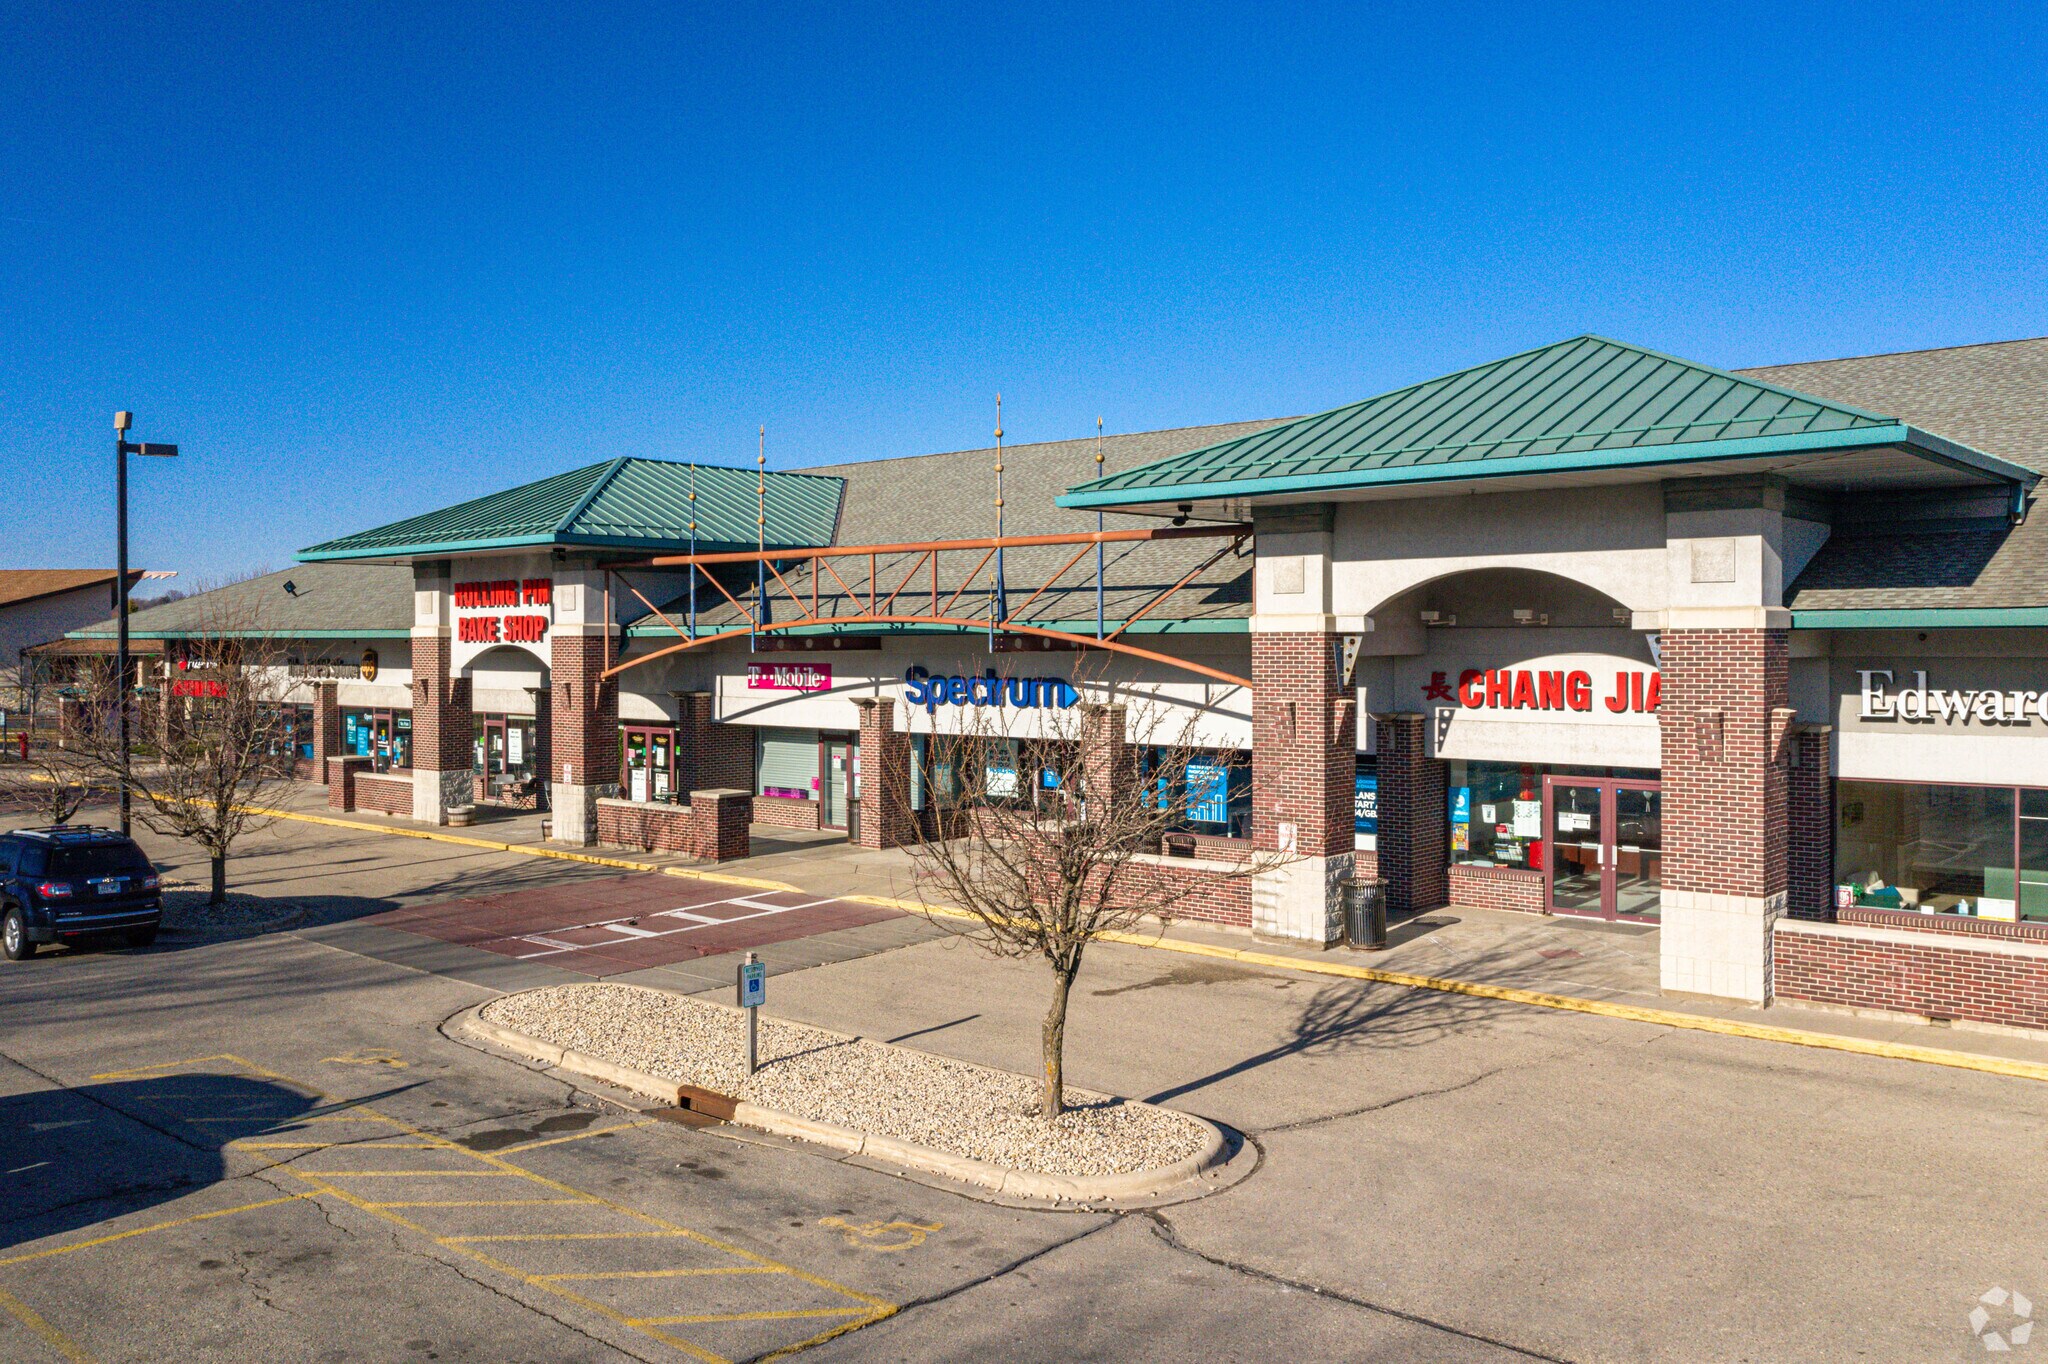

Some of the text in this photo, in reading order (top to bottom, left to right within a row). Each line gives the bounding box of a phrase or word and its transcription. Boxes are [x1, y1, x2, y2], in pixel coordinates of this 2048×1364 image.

[454, 578, 552, 607] ROLLING PIN
[458, 615, 547, 642] BAKE SHOP
[905, 665, 1065, 714] Spectrum
[1421, 671, 1455, 702] 長
[1458, 668, 1591, 712] CHANG
